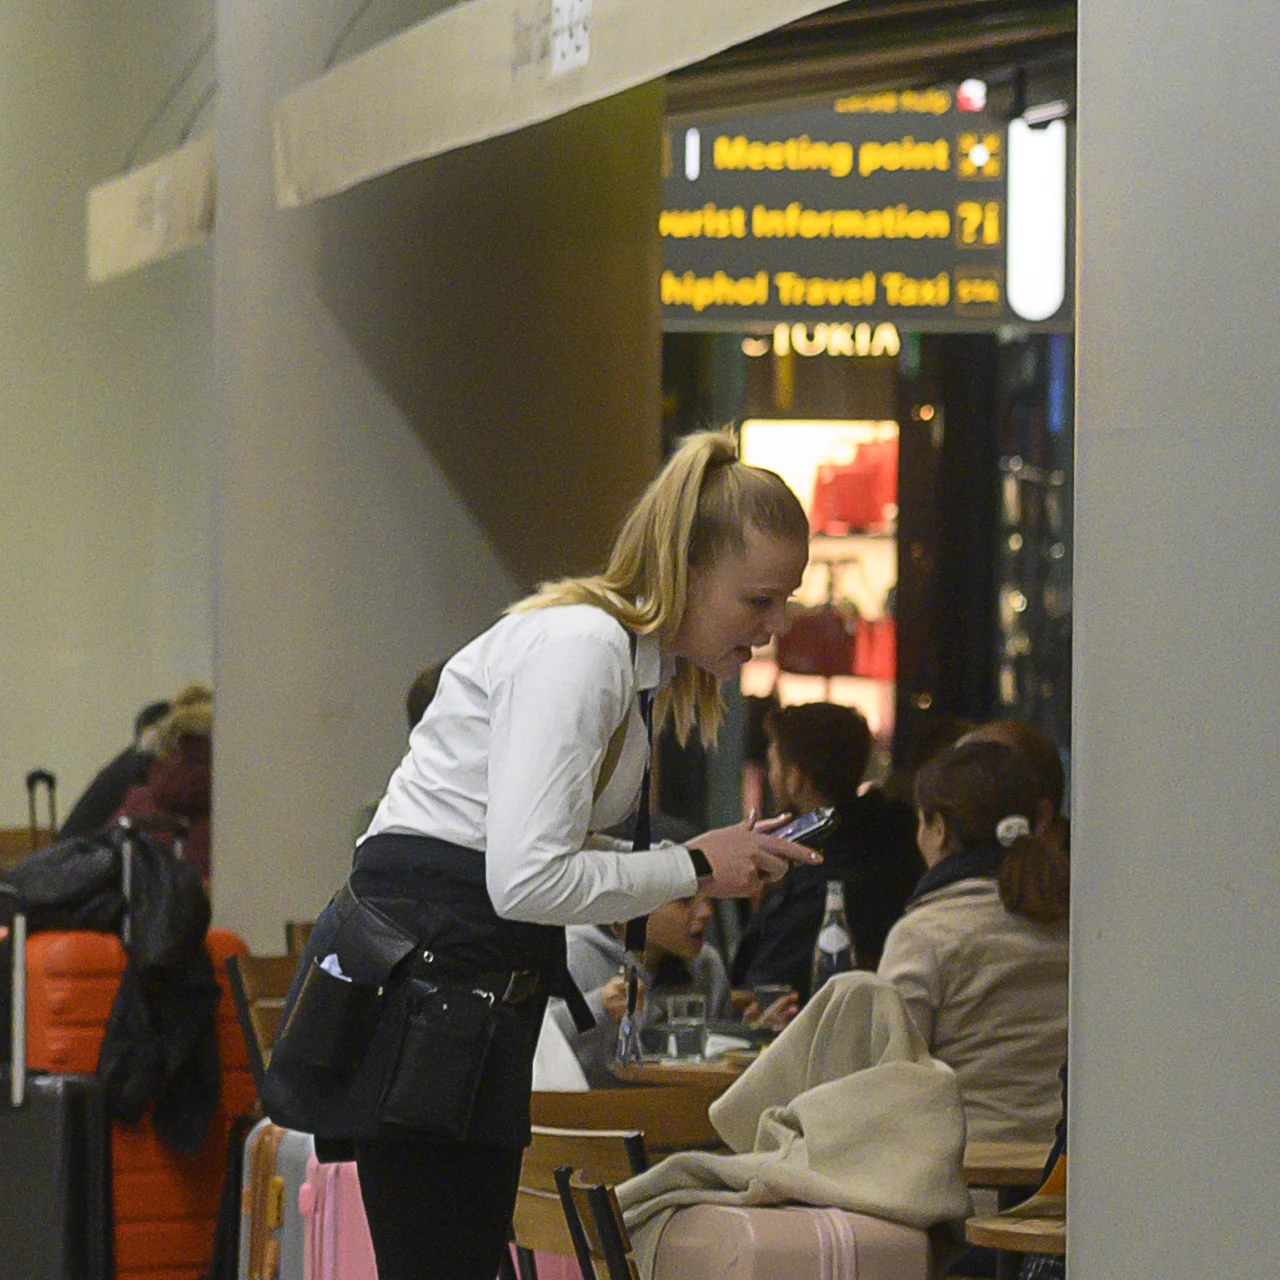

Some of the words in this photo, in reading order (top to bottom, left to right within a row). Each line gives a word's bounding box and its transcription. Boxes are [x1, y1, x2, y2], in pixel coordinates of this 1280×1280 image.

[712, 134, 854, 177] Meeting
[858, 134, 951, 177] point
[773, 270, 877, 307] Travel
[880, 270, 952, 307] Taxi
